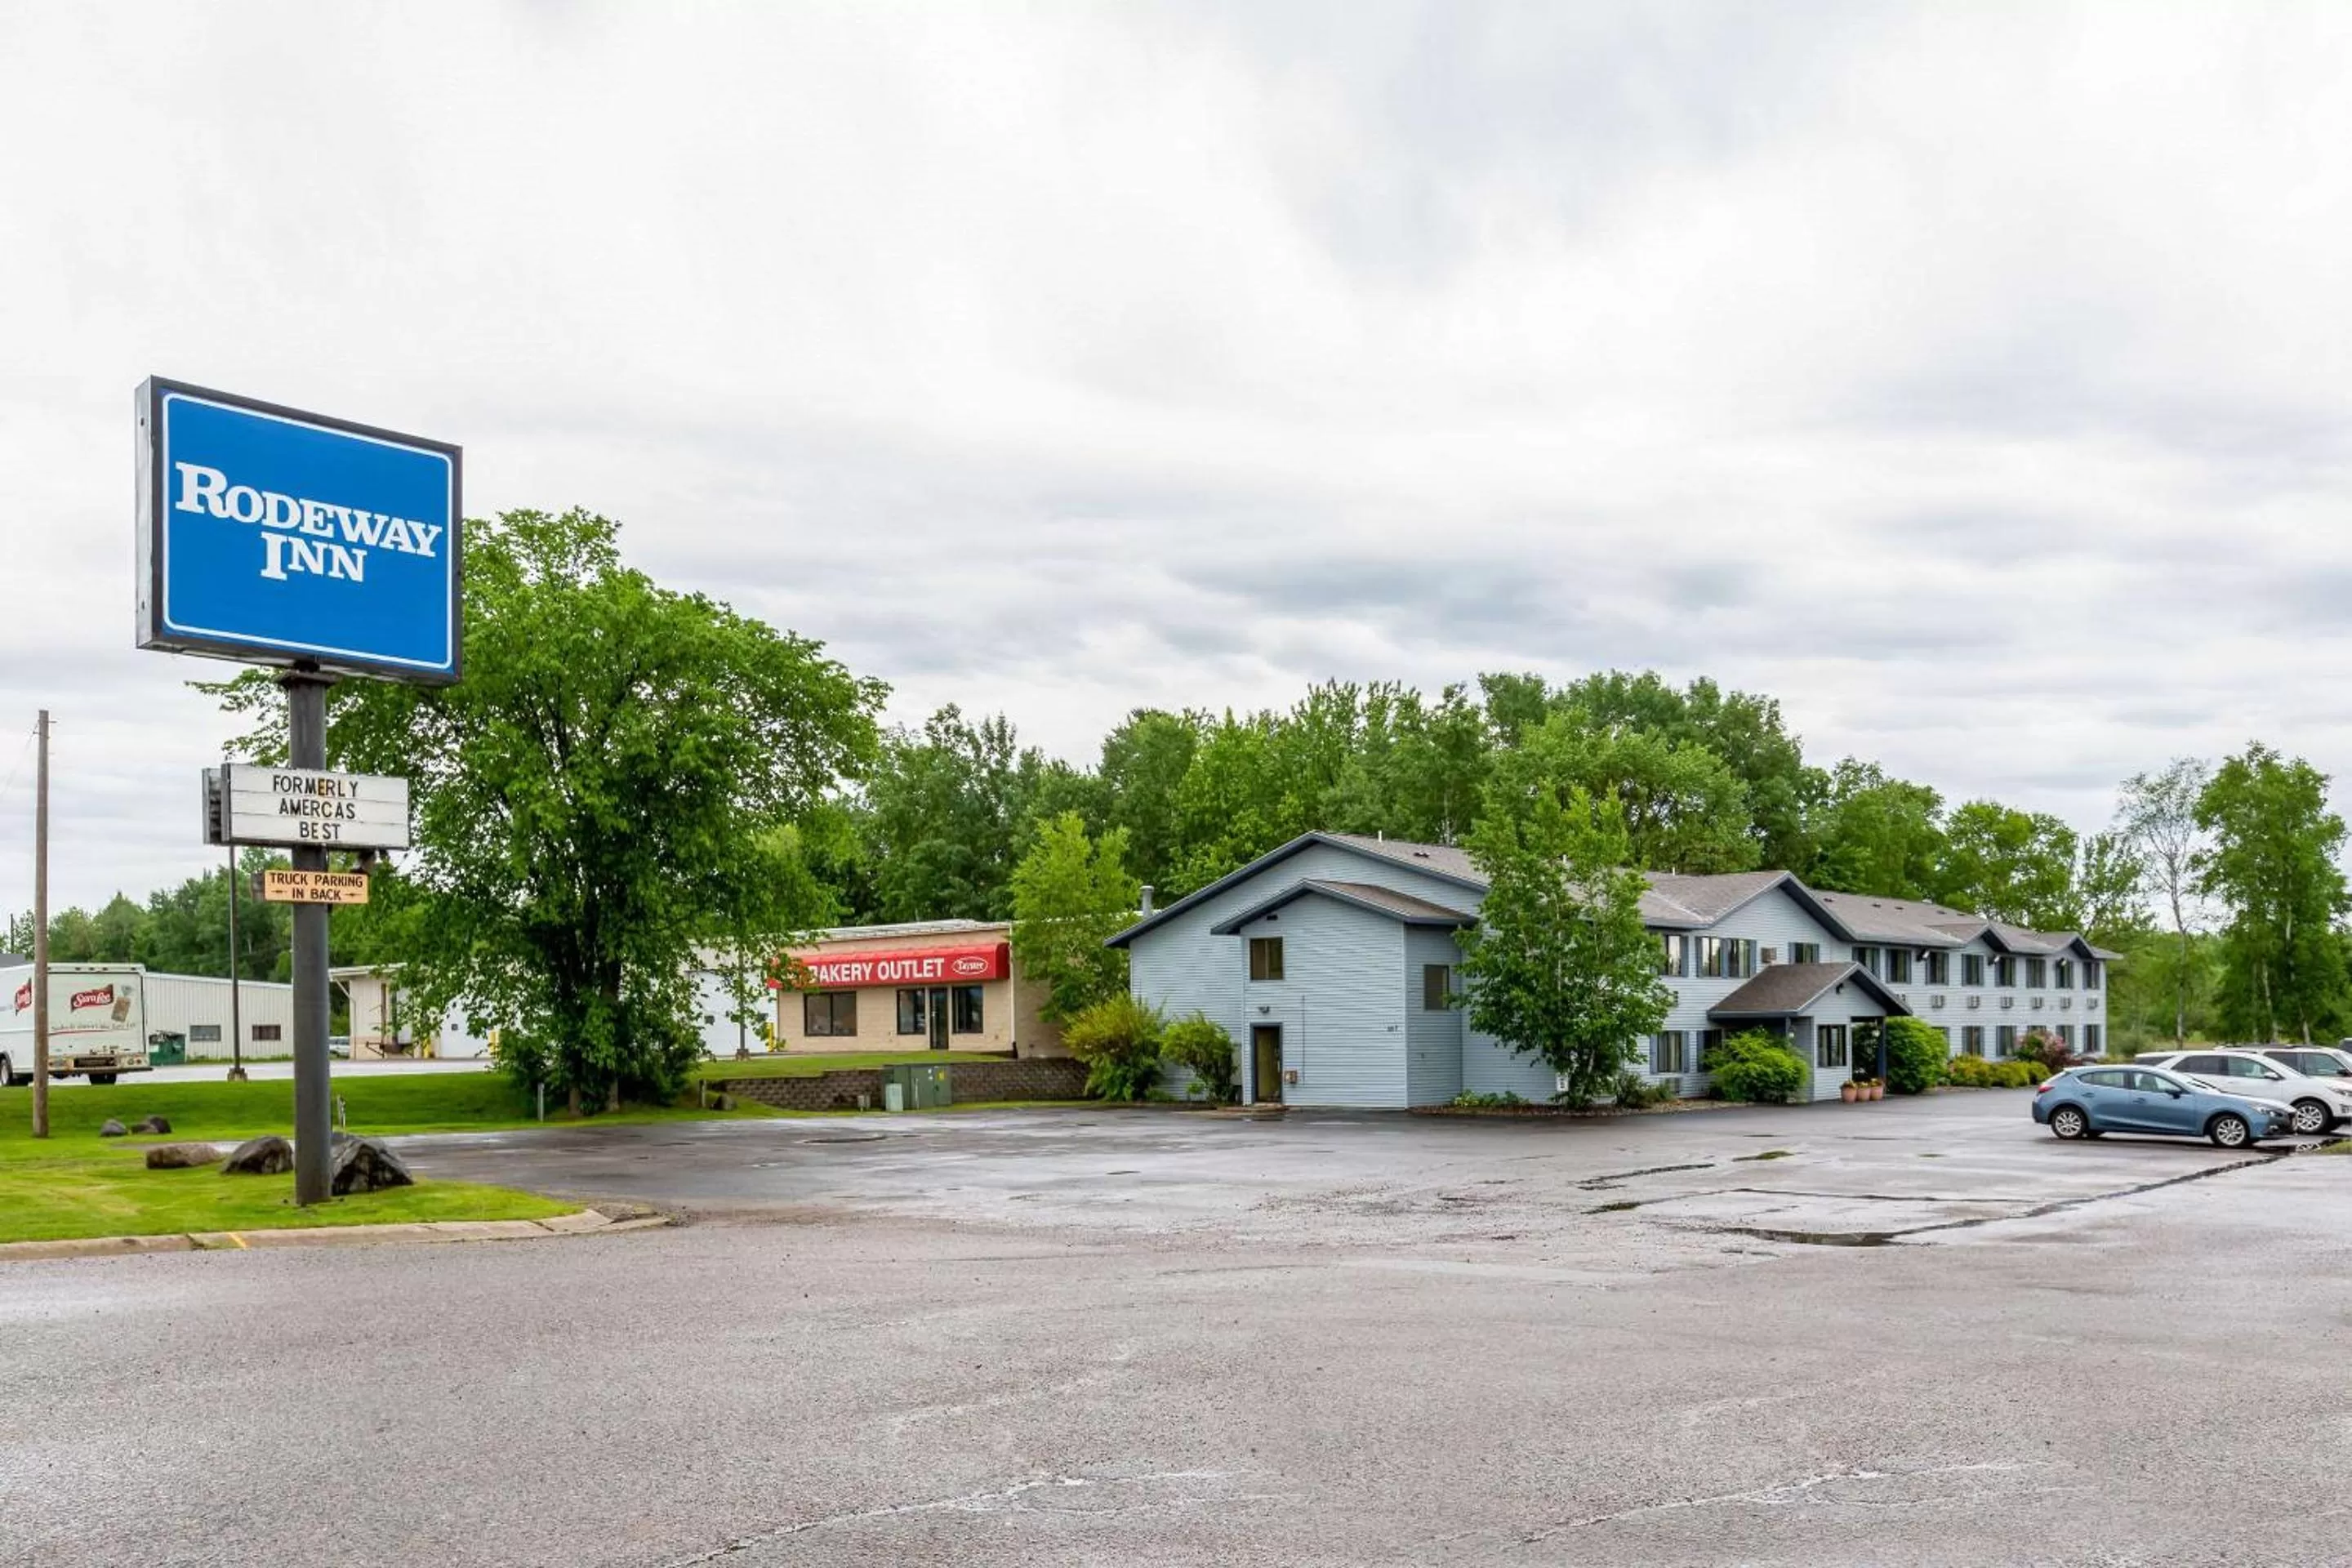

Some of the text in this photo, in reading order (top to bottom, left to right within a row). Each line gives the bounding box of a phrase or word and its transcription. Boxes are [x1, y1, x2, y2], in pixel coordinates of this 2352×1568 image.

[175, 462, 442, 557] RODEWAY
[261, 532, 367, 582] INN
[273, 775, 359, 797] FORMERLY
[279, 799, 355, 819] AMERCAS
[300, 821, 341, 840] BEST
[270, 872, 363, 888] TRUCK PARKING
[292, 889, 341, 900] IN BACK
[877, 958, 945, 980] OUTLET
